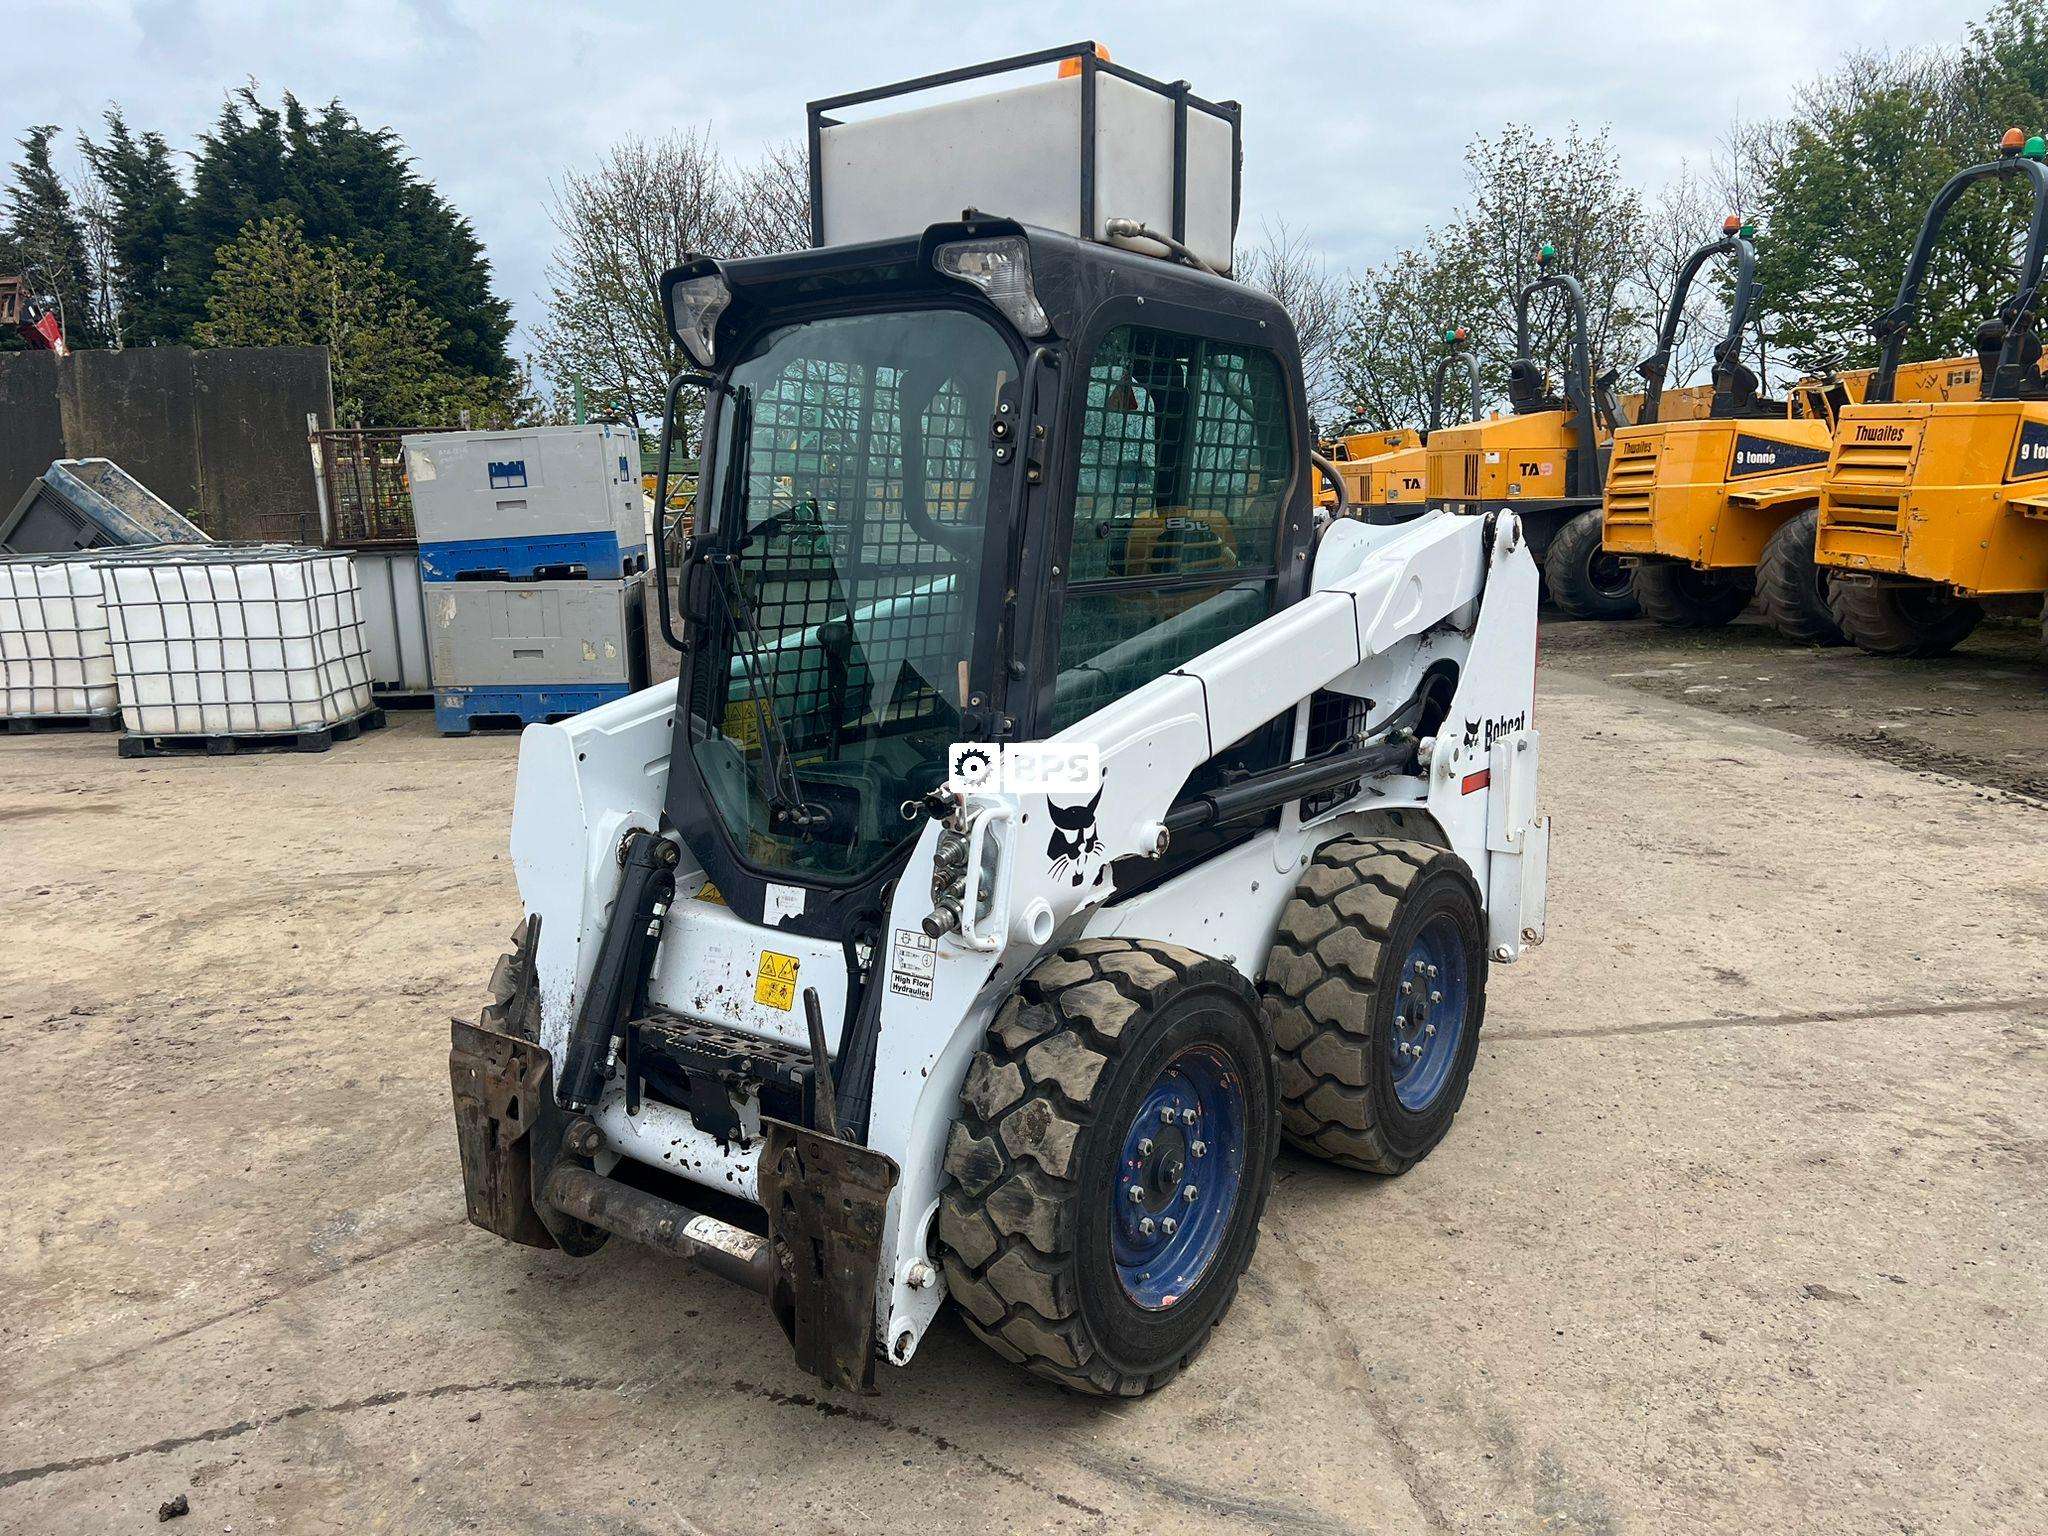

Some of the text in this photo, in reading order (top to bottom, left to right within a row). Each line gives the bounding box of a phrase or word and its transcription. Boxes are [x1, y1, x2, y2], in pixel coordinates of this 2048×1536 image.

[1855, 425, 1905, 442] Thwaites
[1623, 441, 1652, 455] Thwaites
[2021, 443, 2048, 460] 9 to
[1736, 450, 1776, 465] 9 tonne
[894, 974, 930, 988] High Flow
[892, 983, 930, 997] Hydraulics
